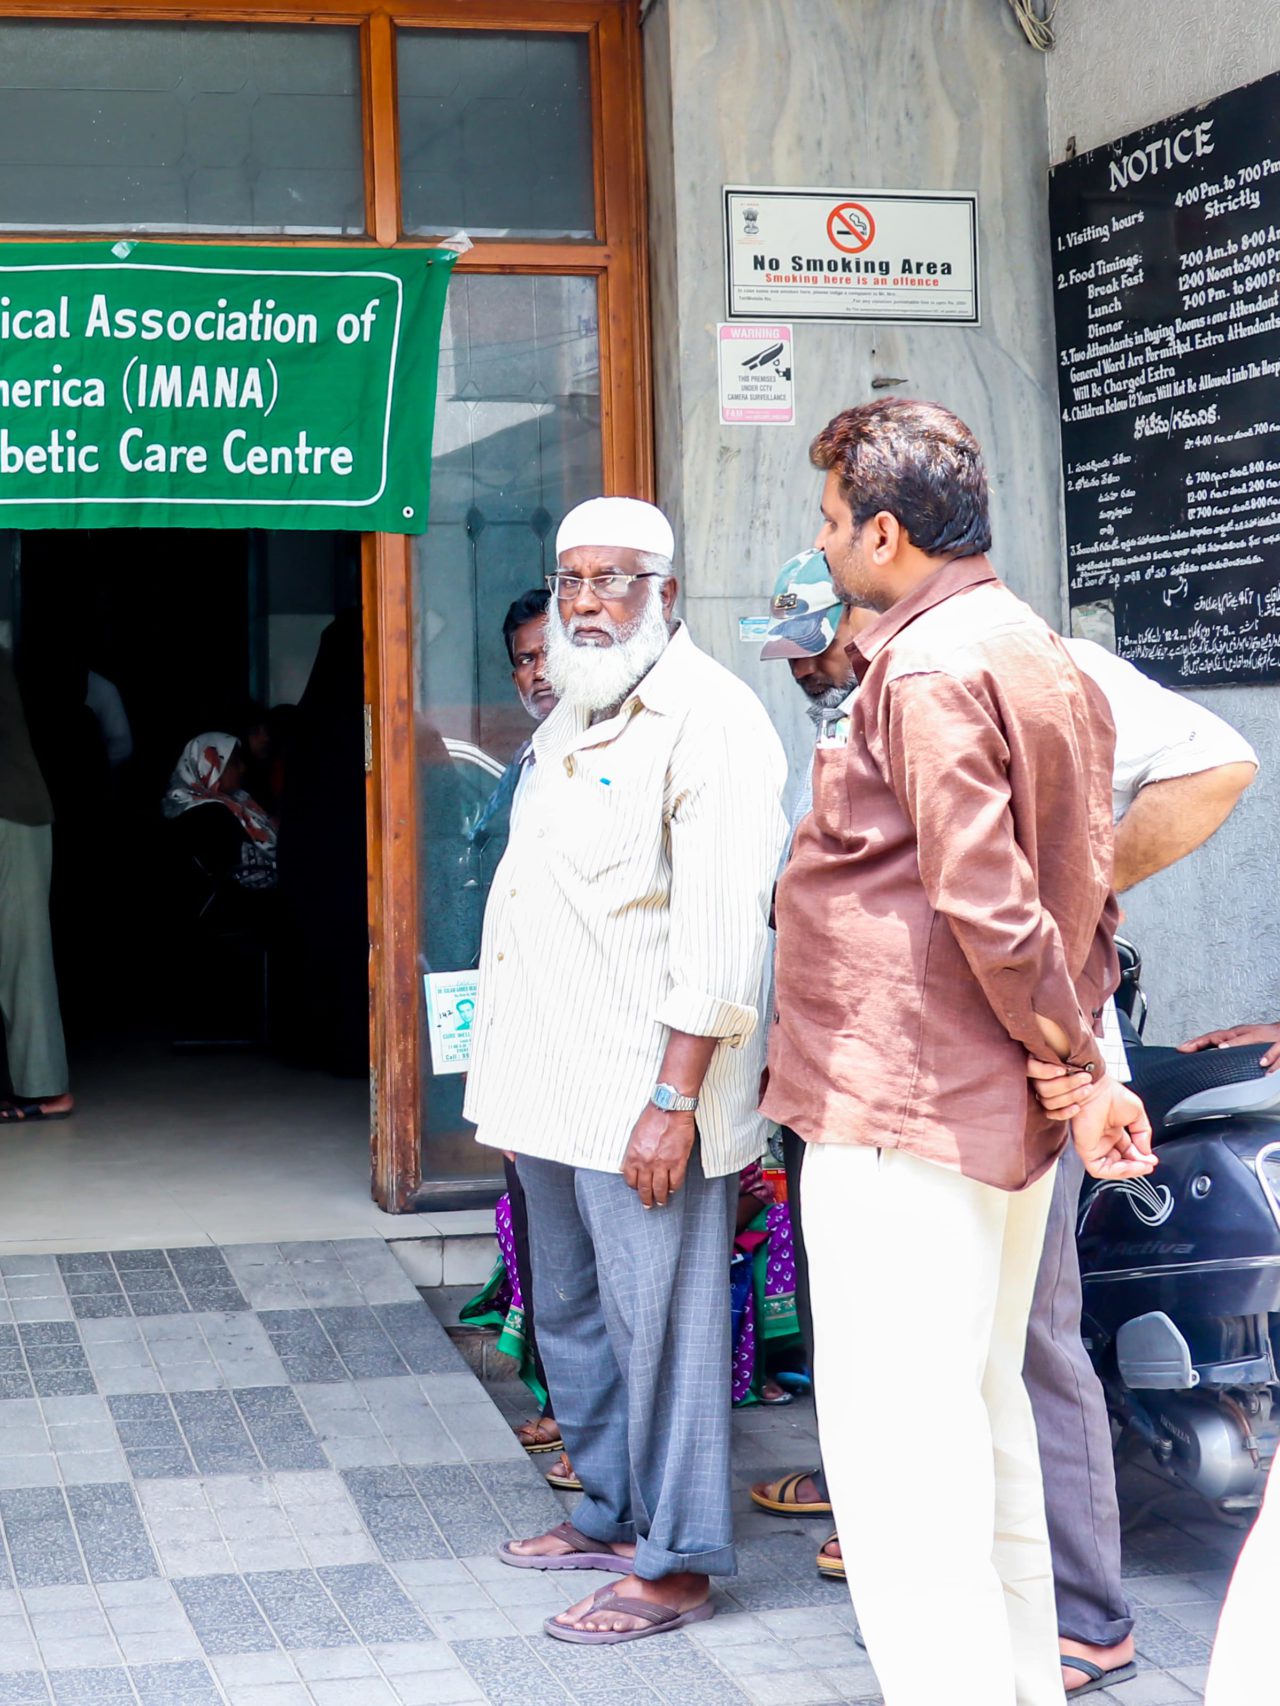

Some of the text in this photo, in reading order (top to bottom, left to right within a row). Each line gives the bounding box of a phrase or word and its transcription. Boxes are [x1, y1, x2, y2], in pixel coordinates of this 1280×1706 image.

[1109, 119, 1215, 192] NOTICE
[1204, 187, 1261, 220] Strictly
[1066, 225, 1110, 248] Visiting
[1111, 209, 1145, 232] hours
[753, 255, 952, 275] No Smoking Area
[766, 273, 818, 285] Smoking
[824, 274, 852, 285] here
[857, 275, 868, 285] is
[873, 277, 888, 286] an
[1069, 262, 1096, 285] Food
[1096, 254, 1143, 276] Timings:
[1206, 265, 1233, 282] Noon
[1233, 258, 1244, 274] to
[1087, 268, 1144, 299] Break Fast
[1232, 280, 1244, 295] to
[85, 294, 319, 345] Association
[336, 298, 380, 345] of
[1088, 295, 1122, 320] Lunch
[731, 328, 780, 338] WARNING
[1086, 334, 1134, 360] Attendants
[1134, 331, 1144, 345] in
[1175, 317, 1206, 334] Rooms
[1229, 290, 1279, 320] Attendant
[1088, 320, 1124, 339] Dinner
[1070, 360, 1102, 383] General
[1102, 353, 1126, 374] Ward
[1127, 351, 1144, 368] Are
[1195, 330, 1225, 350] Extra
[123, 355, 279, 417] (IMANA)
[751, 375, 776, 383] PREMISES
[1073, 363, 1176, 401] Will Be Charged Extra
[1105, 396, 1129, 414] Below
[1128, 394, 1138, 409] 12
[1136, 390, 1157, 406] Years
[1156, 383, 1173, 400] Will
[1173, 379, 1186, 396] Not
[1187, 377, 1197, 393] Be
[1199, 368, 1231, 390] Allowed
[1248, 362, 1261, 379] The
[119, 427, 208, 474] Care
[222, 430, 353, 475] Centre
[1111, 1240, 1196, 1256] Activa
